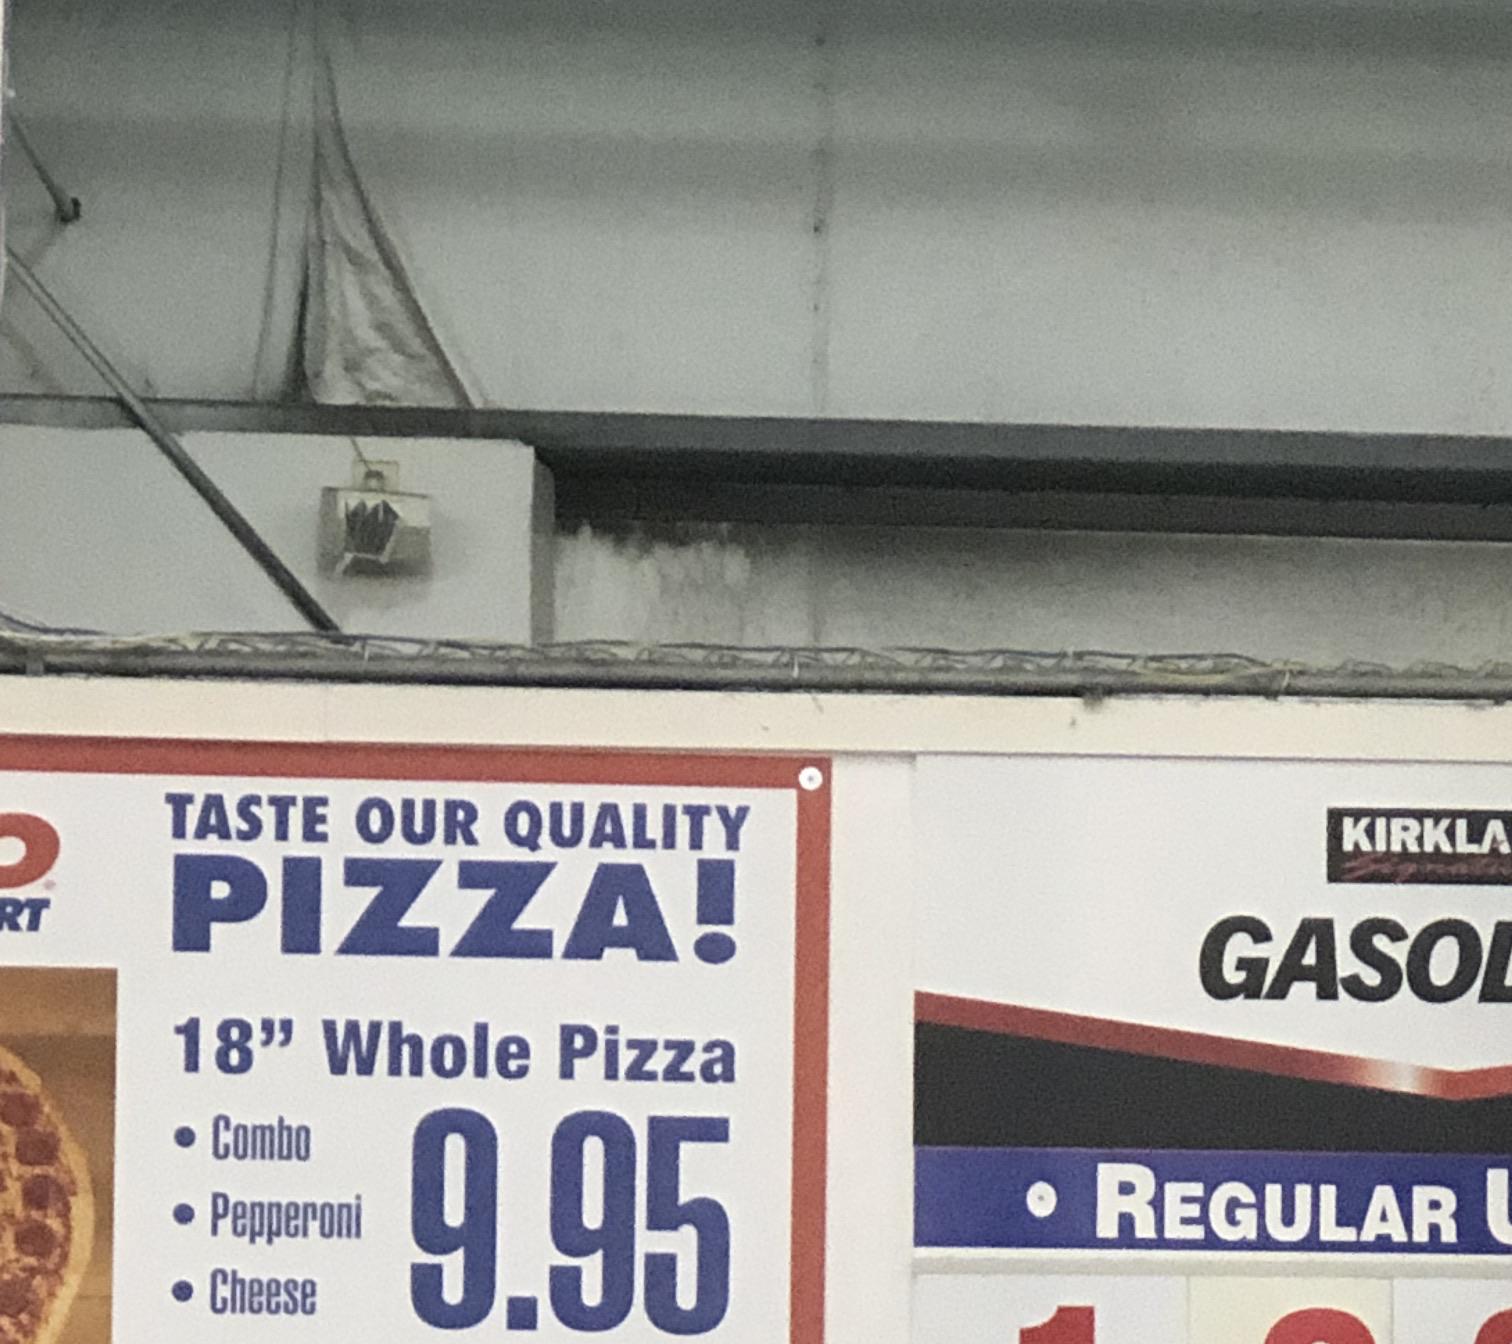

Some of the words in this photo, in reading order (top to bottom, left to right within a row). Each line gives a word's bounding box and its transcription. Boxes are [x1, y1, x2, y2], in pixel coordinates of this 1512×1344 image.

[165, 792, 330, 843] TASTE
[355, 798, 480, 847] OUR
[503, 801, 751, 853] QUALITY
[171, 853, 738, 965] PIZZA!
[322, 1018, 531, 1080] Whole
[559, 1024, 738, 1084] Pizza
[211, 1114, 312, 1163] Combo
[211, 1191, 363, 1246] Pepperoni
[409, 1107, 732, 1337] 9.95
[1095, 1162, 1459, 1245] REGULAR
[210, 1267, 317, 1317] Cheese
